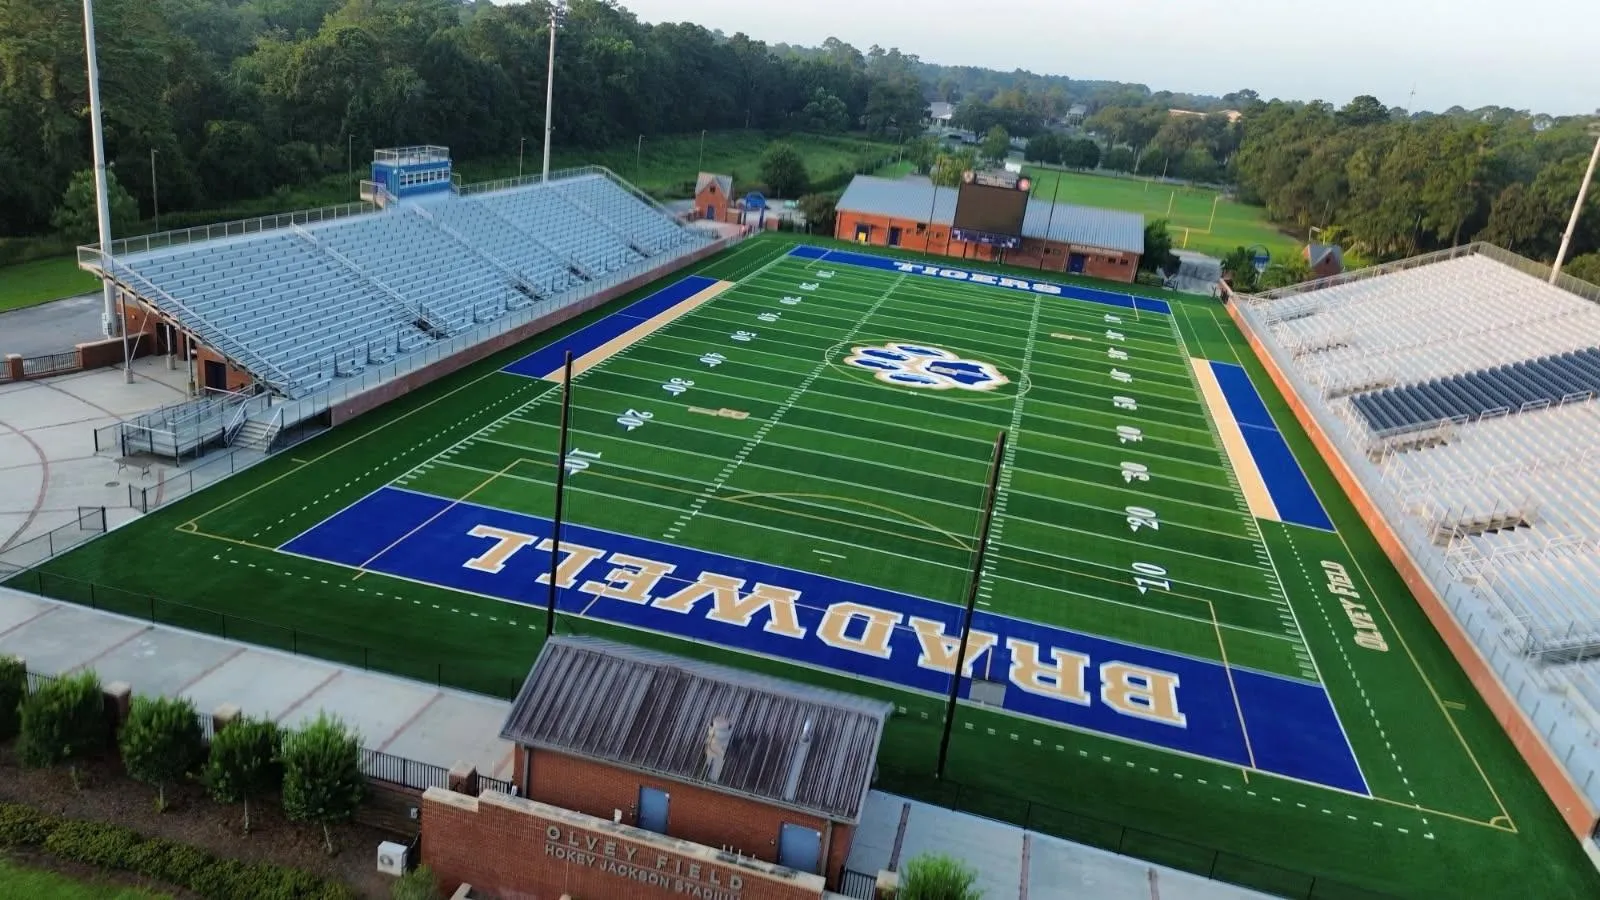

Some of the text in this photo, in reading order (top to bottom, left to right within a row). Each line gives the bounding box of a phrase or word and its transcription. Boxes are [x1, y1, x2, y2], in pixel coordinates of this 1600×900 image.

[893, 261, 1061, 295] TIGERS
[662, 377, 695, 394] 30
[617, 408, 654, 427] 20
[564, 448, 601, 471] 10
[1125, 506, 1159, 530] 20
[1132, 562, 1170, 592] 10
[462, 523, 1188, 728] BRADWELL
[545, 844, 596, 867] HOKEY
[600, 861, 669, 889] JACKSON
[546, 825, 743, 889] OLVEY FIELD
